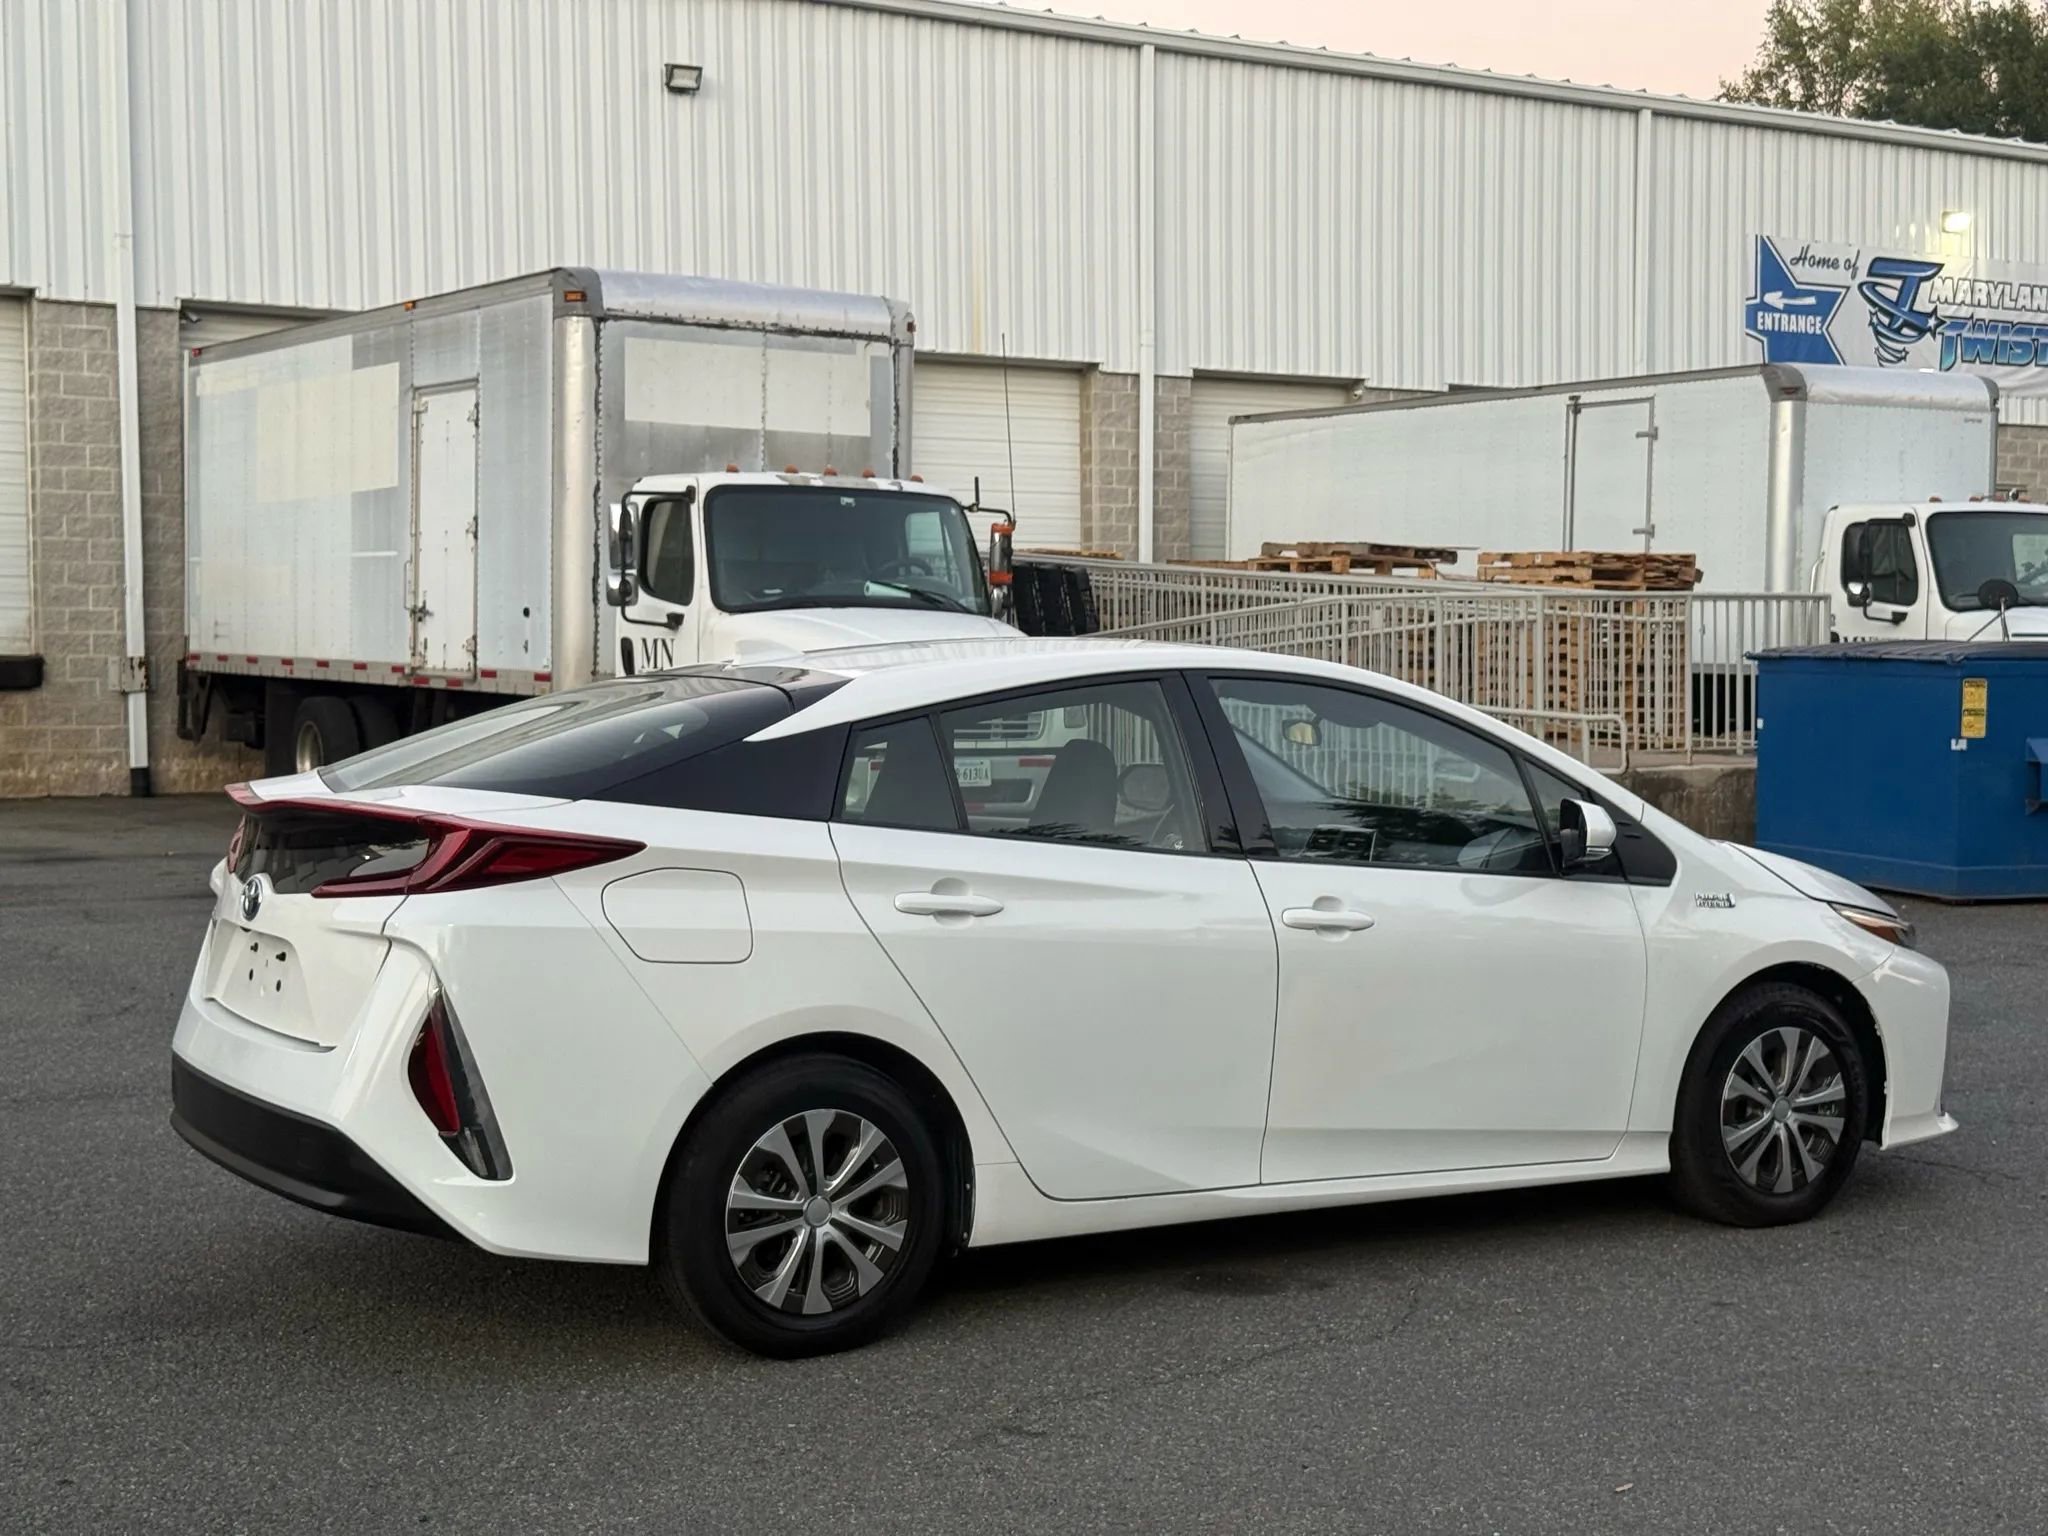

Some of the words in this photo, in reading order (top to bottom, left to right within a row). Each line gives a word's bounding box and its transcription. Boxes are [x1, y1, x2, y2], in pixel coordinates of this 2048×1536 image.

[1790, 244, 1840, 270] Home
[1843, 249, 1860, 280] of
[1757, 311, 1822, 334] ENTRANCE
[641, 637, 675, 671] MN
